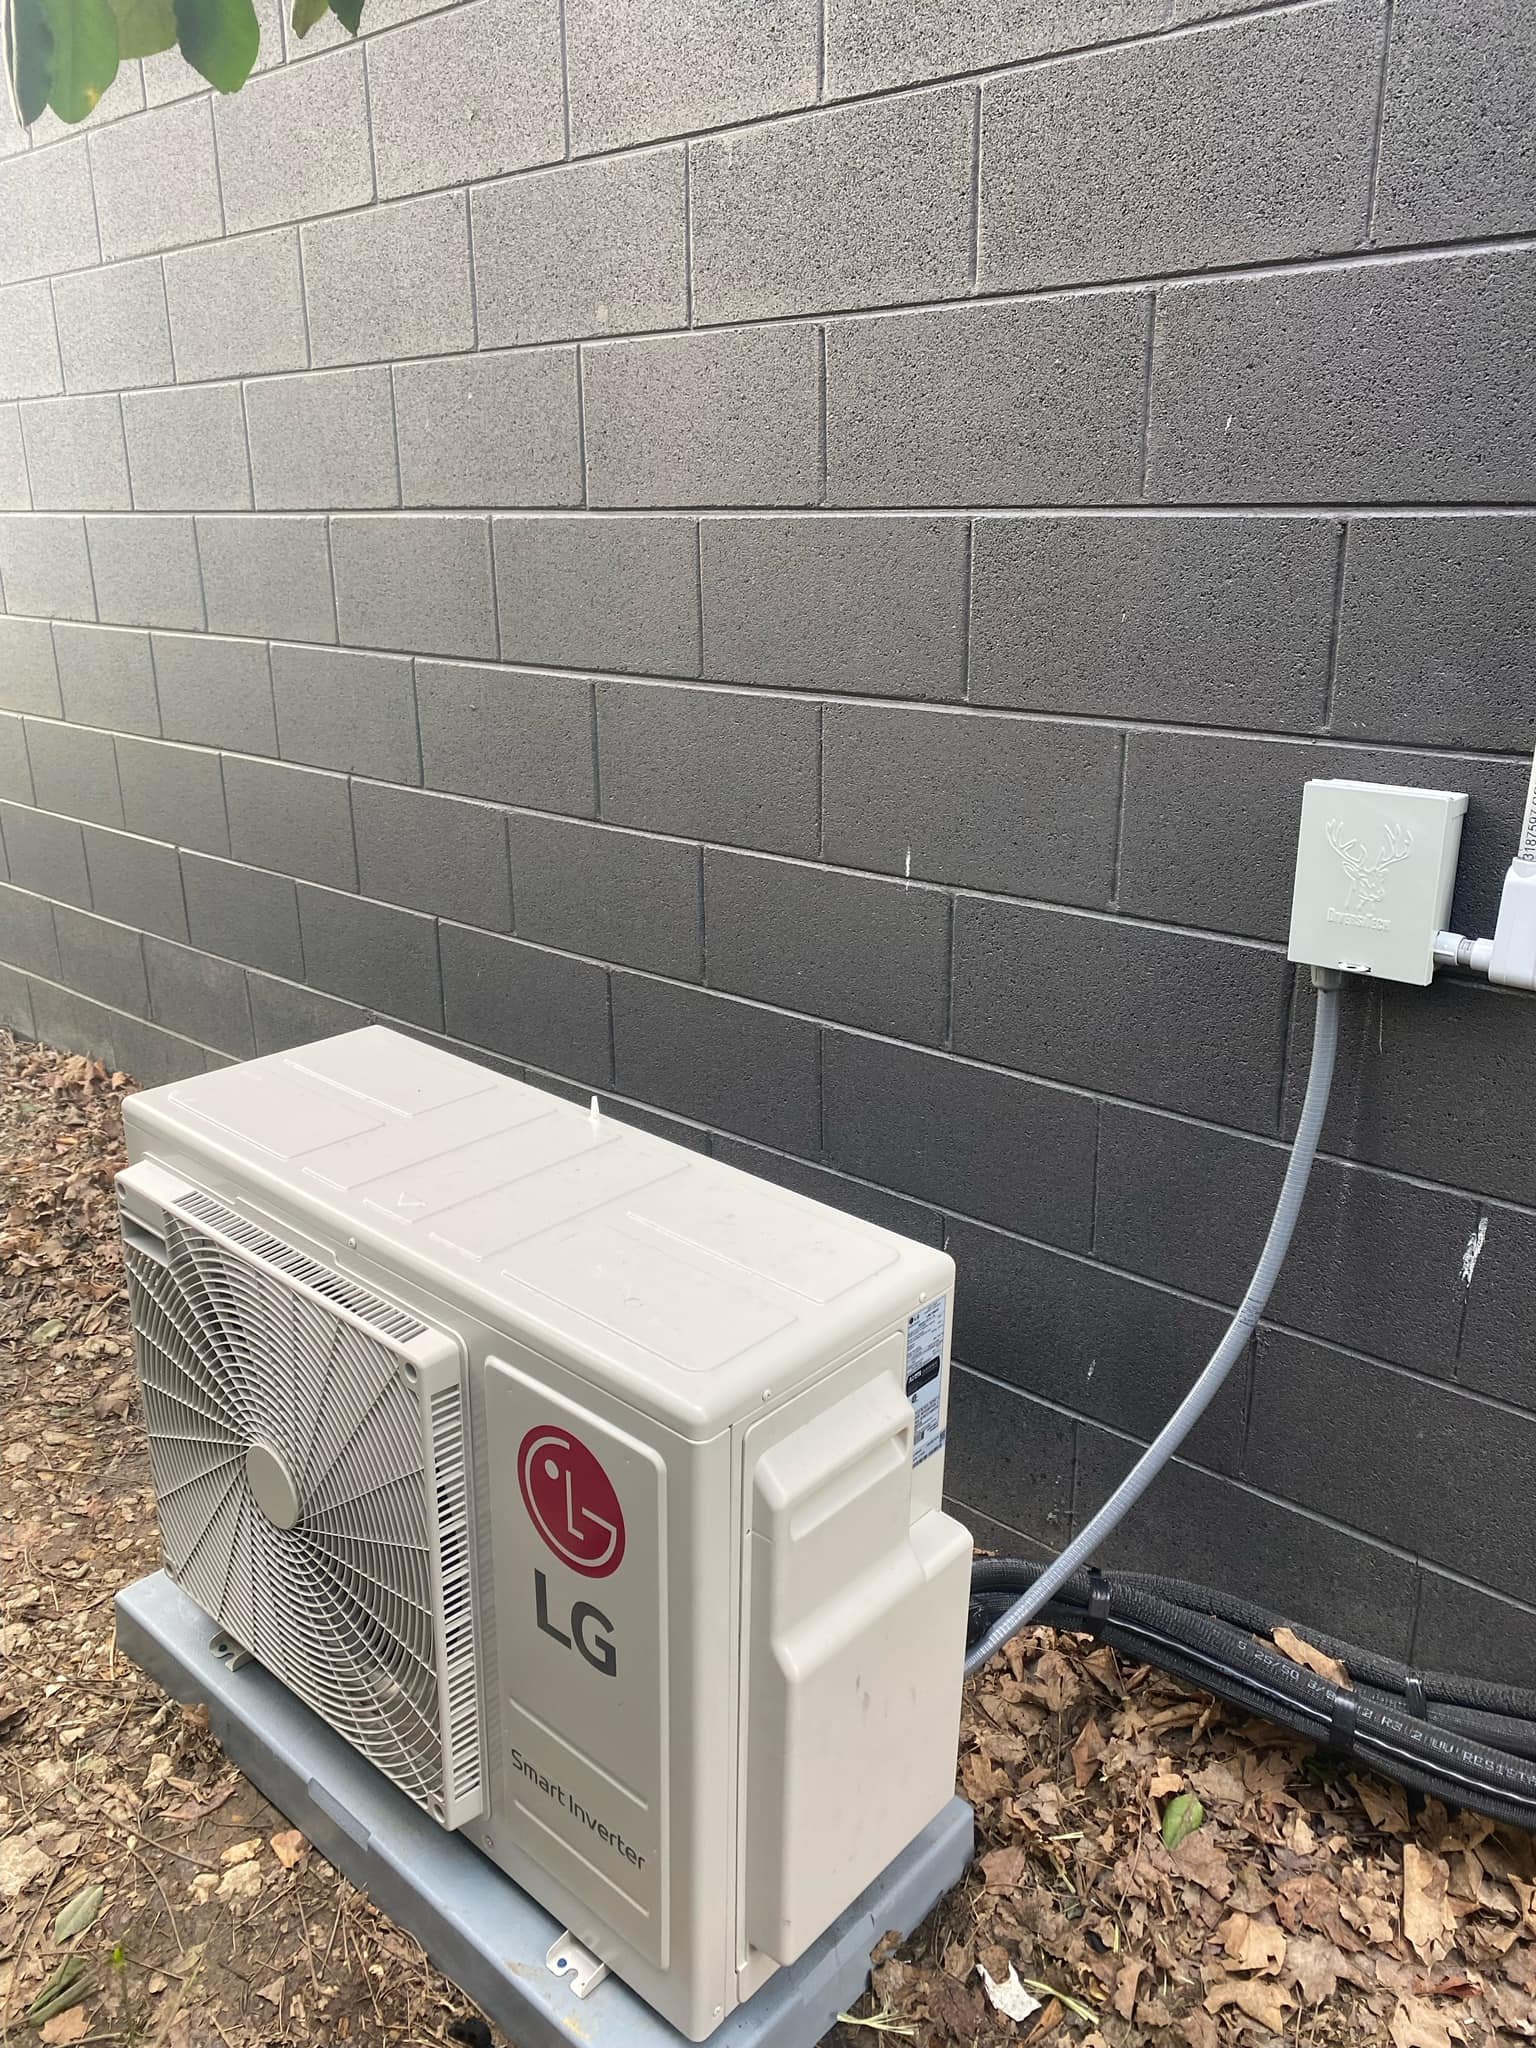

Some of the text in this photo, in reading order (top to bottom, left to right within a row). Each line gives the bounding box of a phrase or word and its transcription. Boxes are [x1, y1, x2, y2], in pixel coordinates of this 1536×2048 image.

[534, 1568, 617, 1677] LG
[511, 1748, 646, 1870] Smart Inverter
